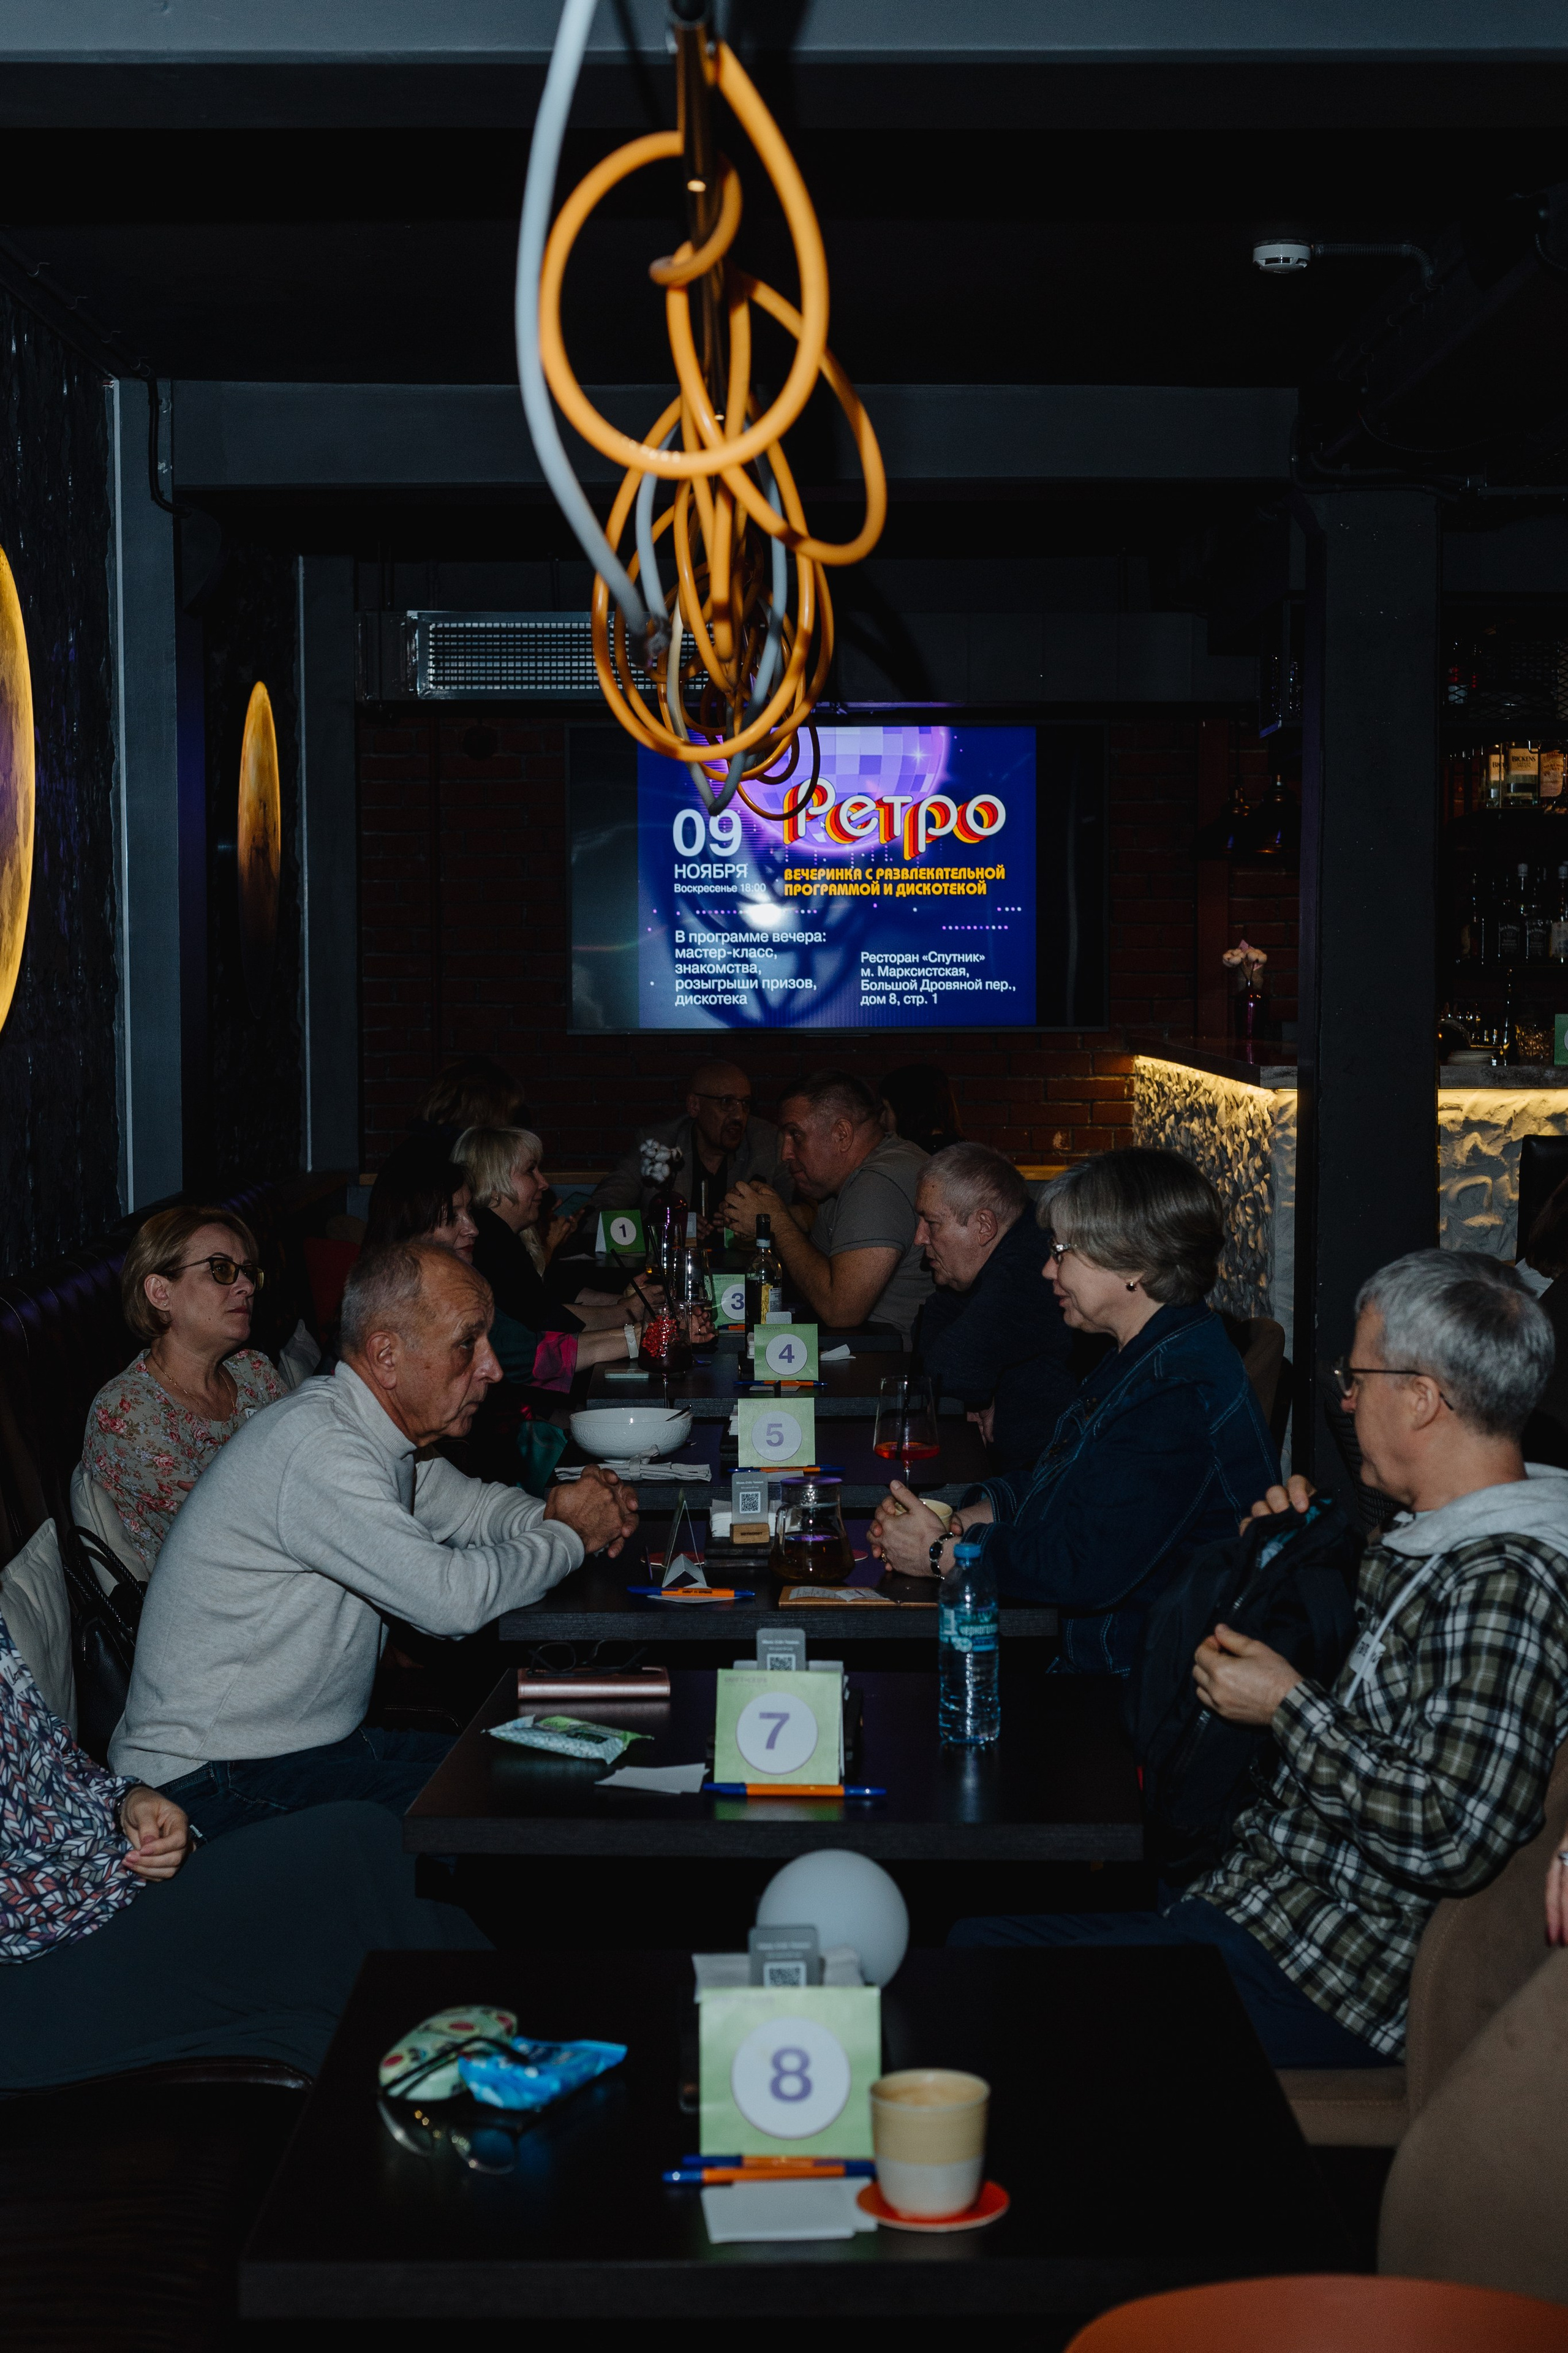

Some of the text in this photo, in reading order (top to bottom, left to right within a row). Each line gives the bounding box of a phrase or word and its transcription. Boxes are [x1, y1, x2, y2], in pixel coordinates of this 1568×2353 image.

[783, 777, 1006, 861] Ретро
[673, 809, 742, 857] 09
[674, 863, 747, 879] НОЯБРЯ
[784, 864, 1006, 880] ВЕЧЕРИНКА С РАЗВЛЕКАТЕЛЬНОЙ
[674, 883, 766, 894] Воскресенье 18:00
[784, 880, 987, 897] ПРОГРАММОЙ И ДИСКОТЕКОЙ
[675, 930, 826, 945] В программе вечера:
[675, 948, 777, 961] мастер-класс,
[861, 951, 986, 965] Ресторан «Спутник»
[675, 963, 761, 976] знакомства,
[861, 965, 970, 979] м. Марксистская,
[675, 978, 817, 992] розыгрыши призов,
[861, 978, 1016, 992] Большой Дровяной пер.,
[674, 994, 747, 1007] дискотека
[860, 993, 938, 1007] дом 8, стр. 1
[619, 1224, 627, 1237] 1
[731, 1293, 745, 1310] 3
[778, 1343, 795, 1364] 4
[766, 1423, 784, 1447] 5
[759, 1712, 790, 1750] 7
[771, 2047, 812, 2102] 8
